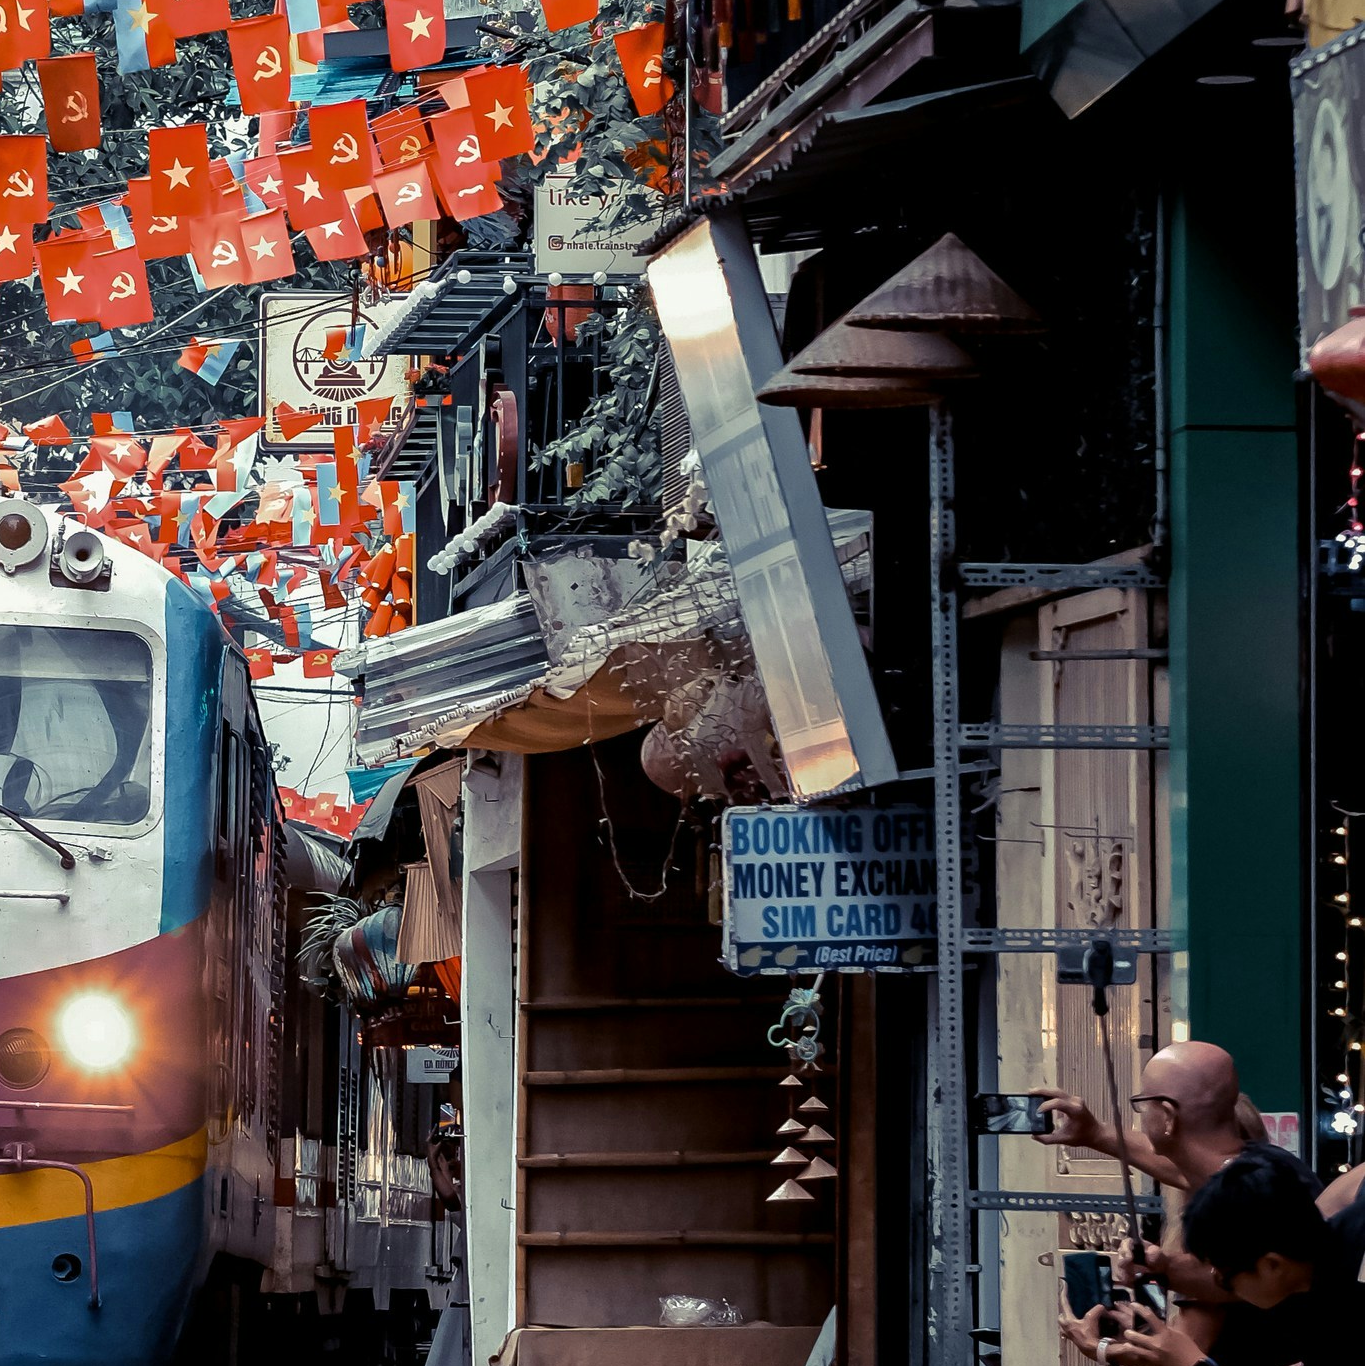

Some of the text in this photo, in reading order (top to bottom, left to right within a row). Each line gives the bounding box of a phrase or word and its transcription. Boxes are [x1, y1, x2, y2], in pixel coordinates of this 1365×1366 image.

[732, 814, 863, 856] BOOKING
[735, 857, 974, 899] MONEY EXCHANE
[762, 905, 816, 939] SIM
[826, 903, 901, 937] CARD
